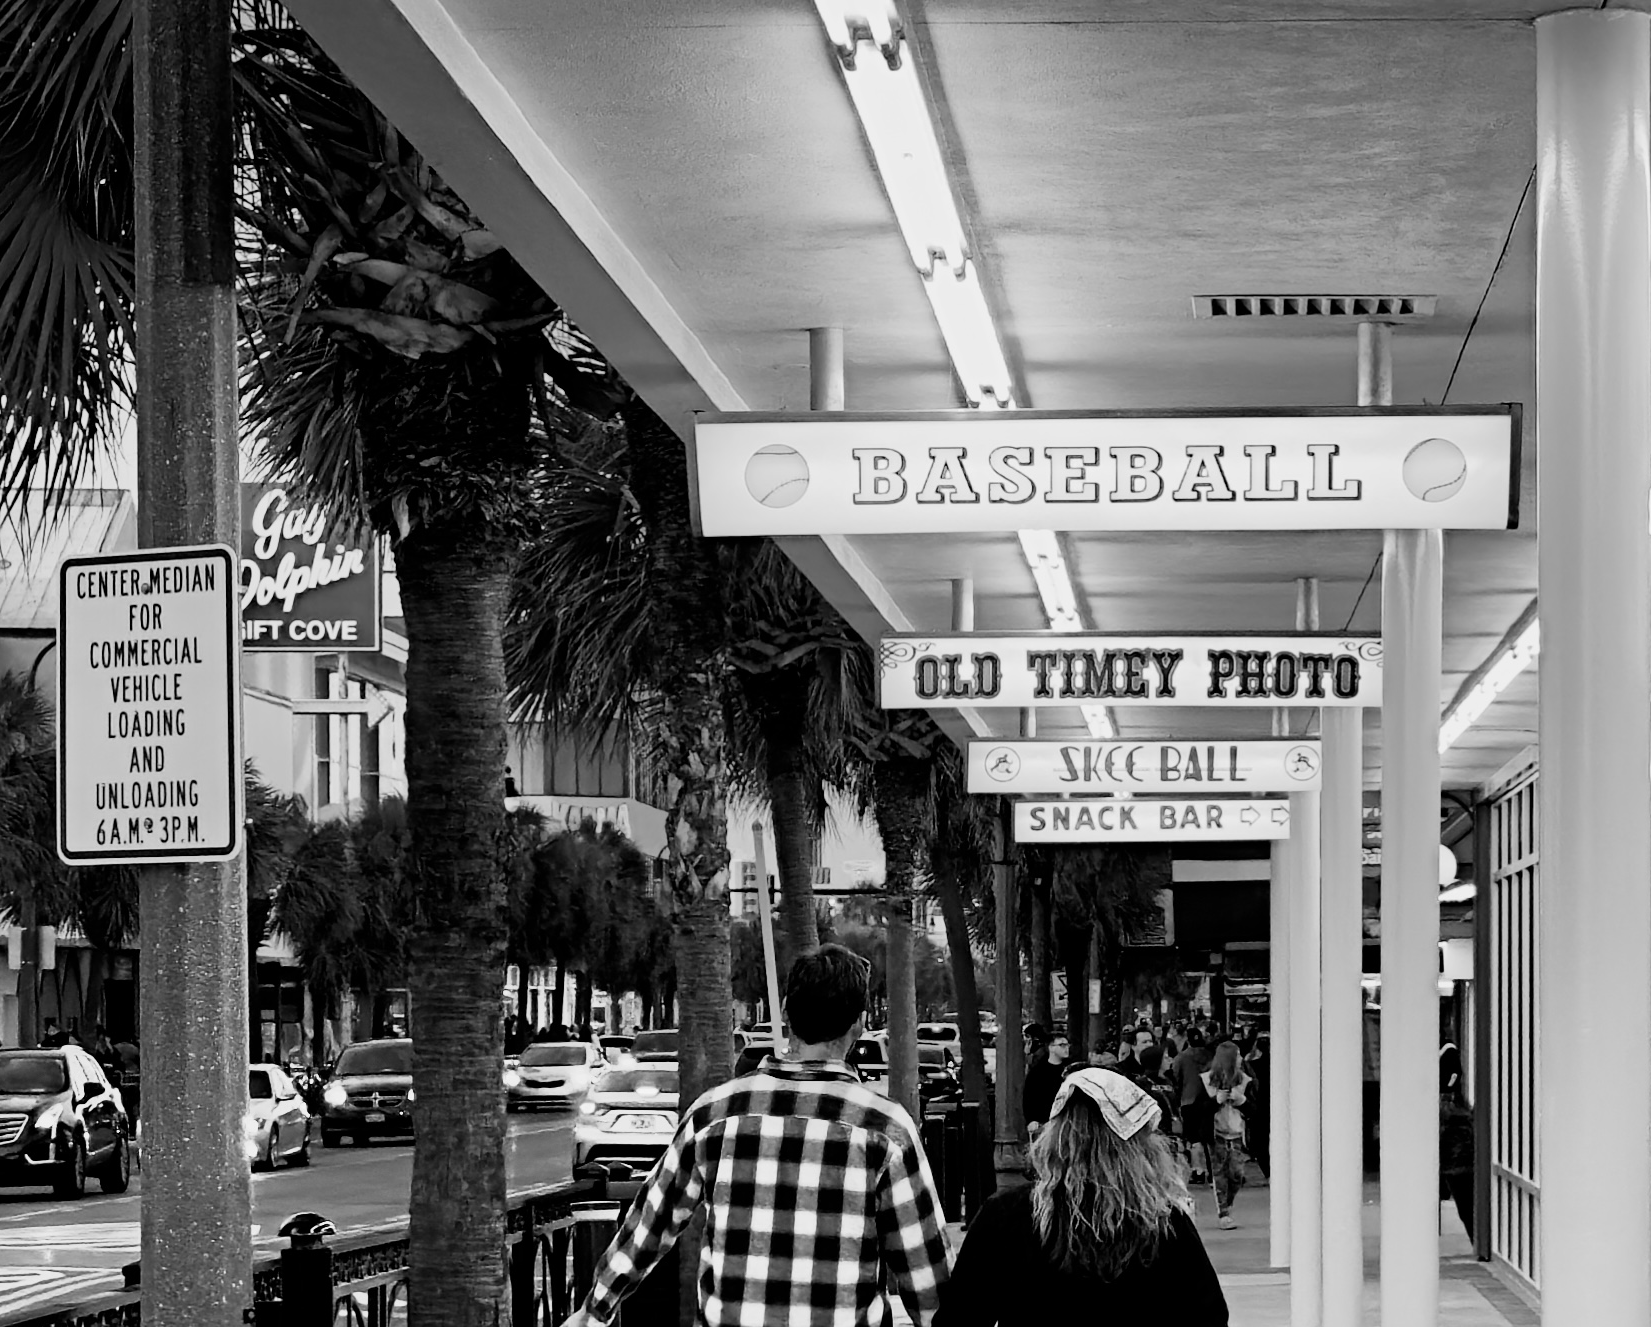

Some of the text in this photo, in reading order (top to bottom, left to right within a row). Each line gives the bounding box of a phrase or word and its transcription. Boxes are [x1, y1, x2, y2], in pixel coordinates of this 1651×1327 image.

[851, 441, 1363, 507] BASEBALL
[77, 564, 215, 599] CENTER MEDIAN
[129, 603, 162, 631] FOR
[289, 619, 358, 641] COVE
[90, 636, 203, 669] COMMERCIAL
[110, 673, 183, 703] VEHICLE
[915, 647, 1361, 700] OLD TIMEY PHOTO
[108, 709, 186, 739] LOADING
[129, 745, 165, 773] AND
[1059, 745, 1247, 782] SKEE BALL
[96, 779, 199, 810] UNLOADING
[1030, 804, 1223, 831] SNACK BAR
